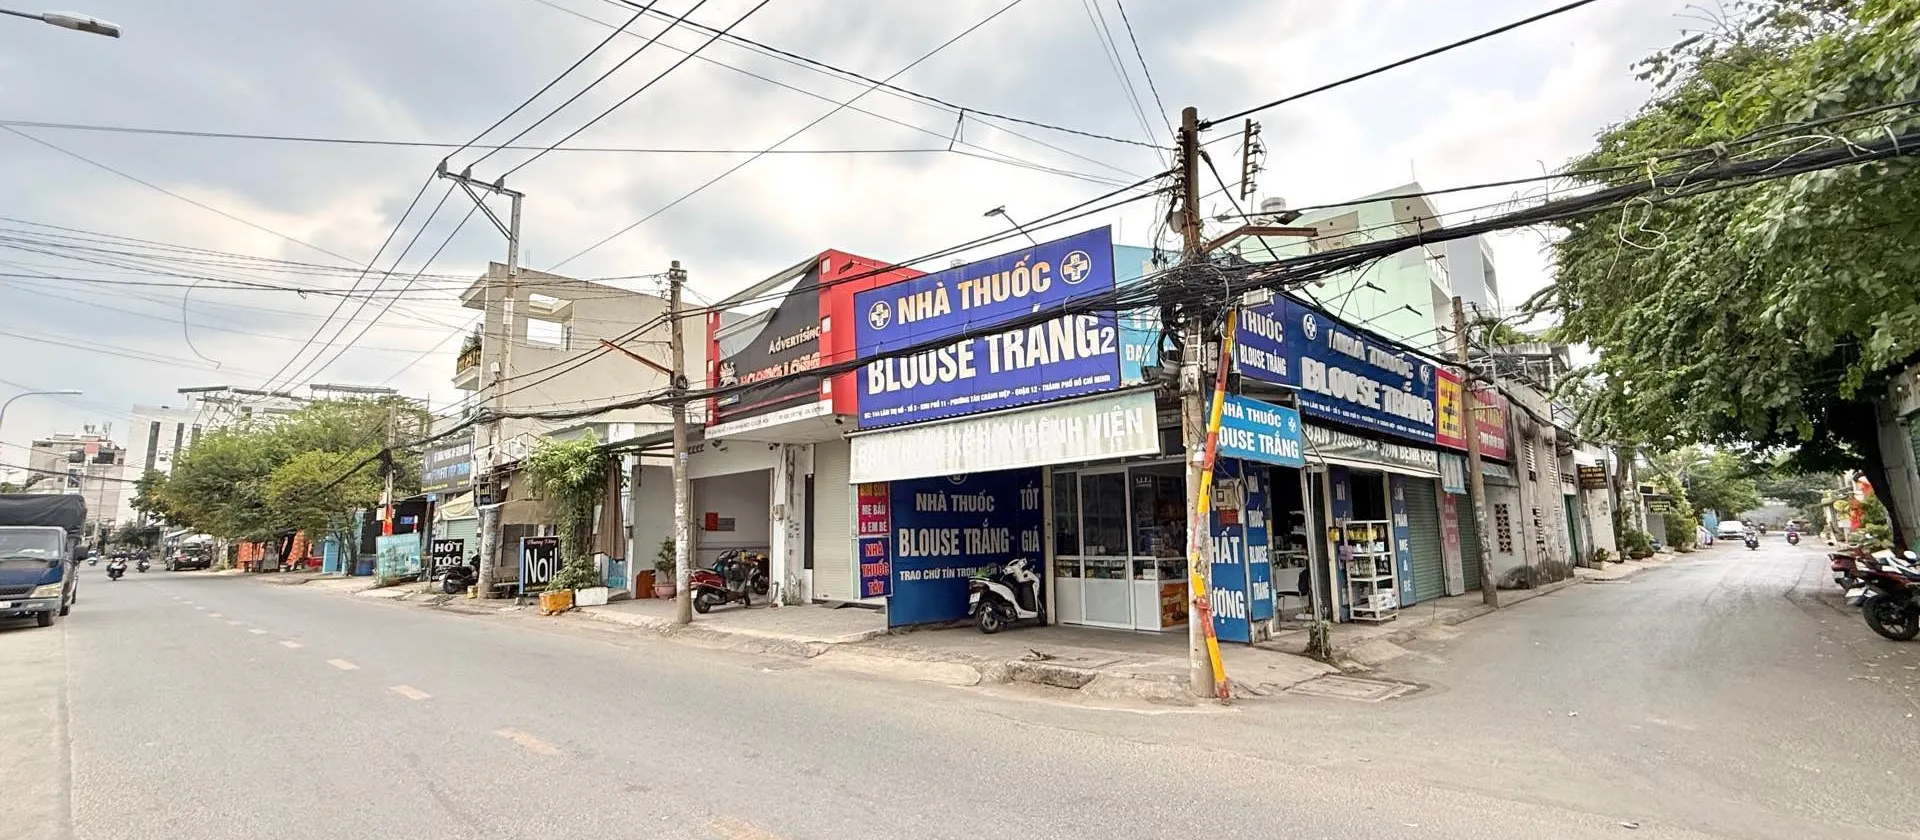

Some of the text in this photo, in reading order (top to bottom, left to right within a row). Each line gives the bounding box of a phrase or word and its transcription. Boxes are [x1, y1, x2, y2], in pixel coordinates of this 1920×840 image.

[898, 254, 1051, 325] NHÀ THUỐC
[1241, 310, 1283, 343] THUỐC
[867, 339, 977, 395] BLOUSE
[1240, 343, 1287, 376] BLOUSE TRẮNG
[1368, 344, 1414, 380] THUỐC
[1301, 356, 1380, 410] BLOUSE
[1087, 405, 1145, 444] VIỆN
[1221, 402, 1281, 428] NHÀ THUỐC
[1206, 424, 1300, 459] OUSE TRẮNG
[916, 488, 995, 512] NHÀ THUỐC
[1020, 480, 1040, 511] TỐT
[868, 521, 878, 533] EM
[899, 518, 1009, 557] BLOUSE TRẮNG
[1021, 525, 1040, 553] GIÁ
[433, 553, 461, 567] TÓC
[434, 541, 463, 553] HỚT
[865, 540, 884, 557] NHÀ
[1210, 526, 1240, 564] HẤT
[525, 547, 558, 585] Nail
[861, 558, 890, 577] THUỐC
[900, 570, 921, 581] TRAO
[1210, 586, 1246, 624] ƯỢNG
